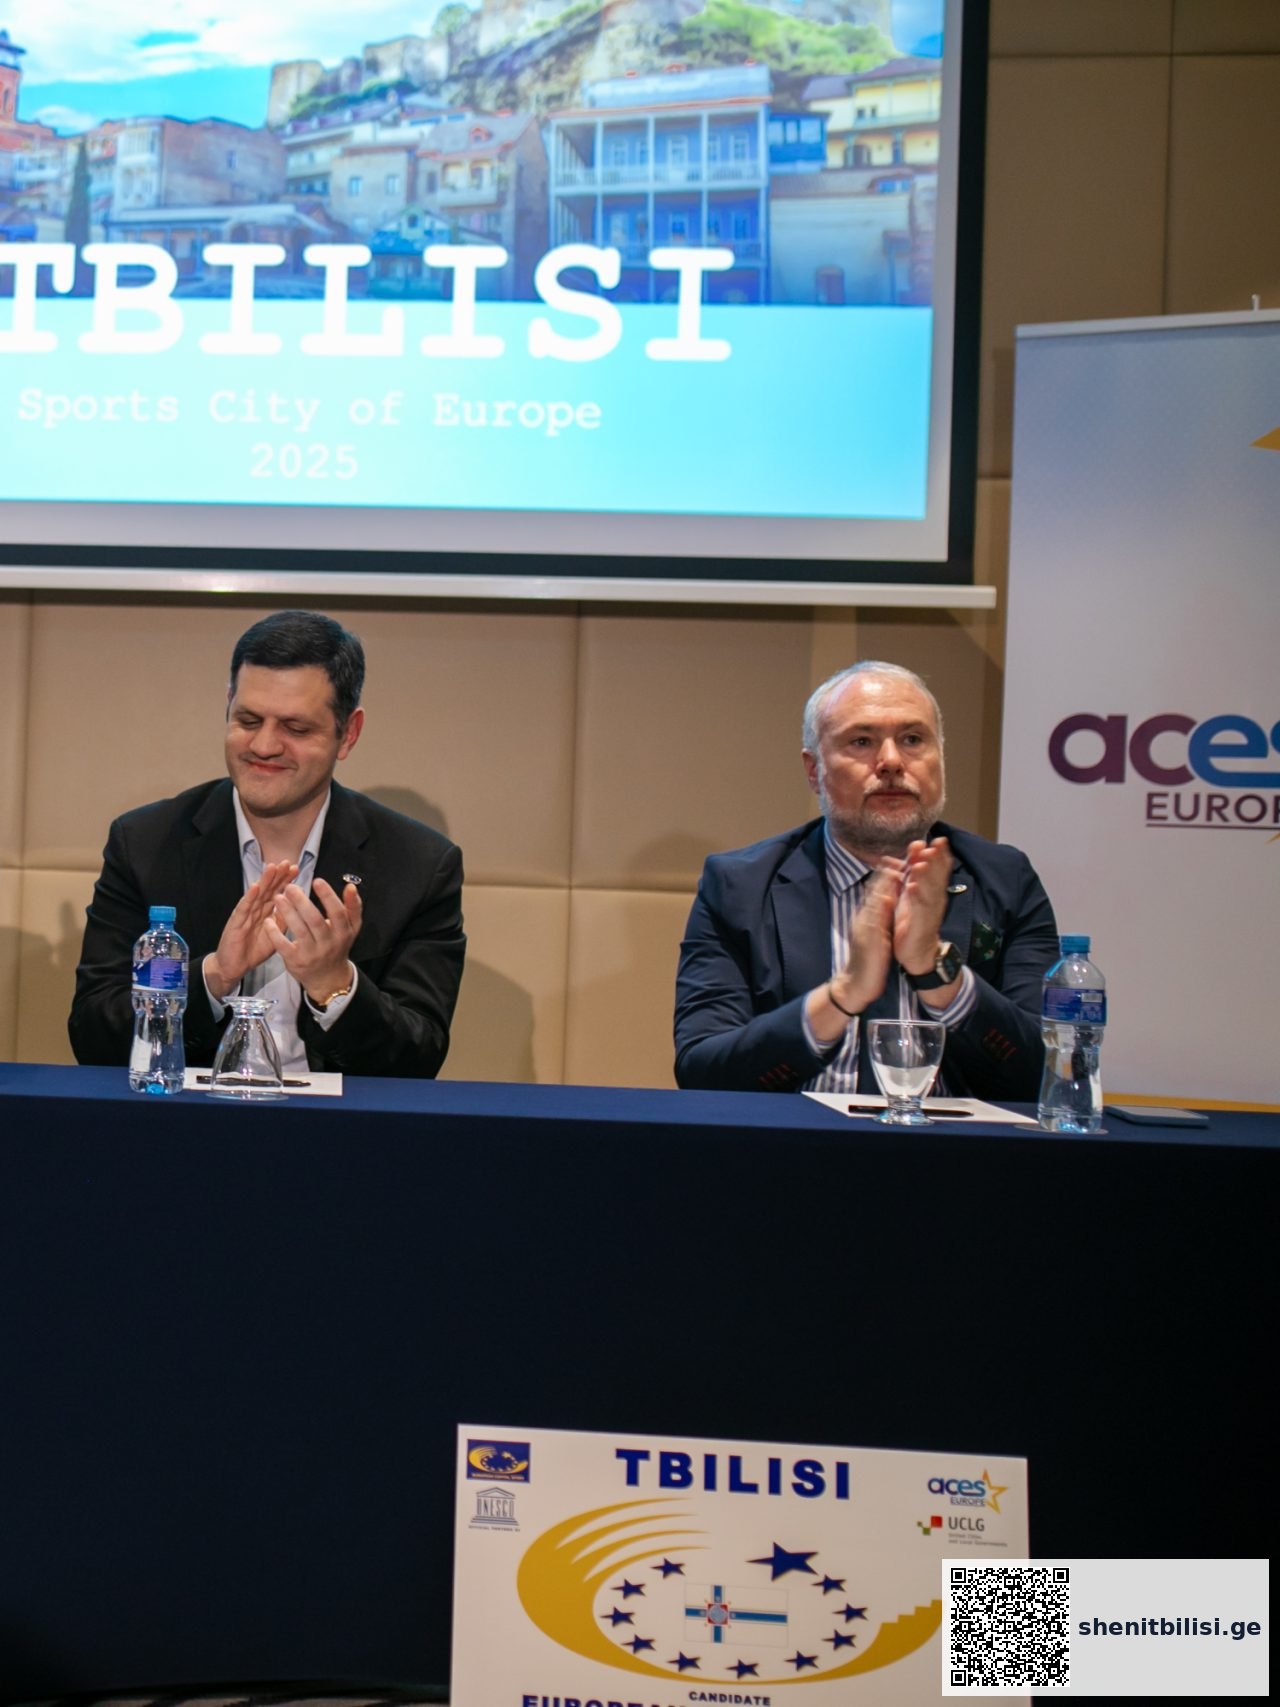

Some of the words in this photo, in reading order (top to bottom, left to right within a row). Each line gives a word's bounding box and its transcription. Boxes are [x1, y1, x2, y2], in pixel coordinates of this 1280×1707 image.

[18, 388, 179, 429] Sports
[209, 389, 320, 432] City
[348, 391, 404, 426] of
[433, 393, 603, 436] Europe
[249, 442, 359, 480] 2025
[1048, 712, 1280, 789] ace
[615, 1448, 850, 1500] TBILISI
[927, 1477, 986, 1498] aces
[948, 1516, 985, 1532] UCLG
[688, 1691, 771, 1706] CANDIDATE
